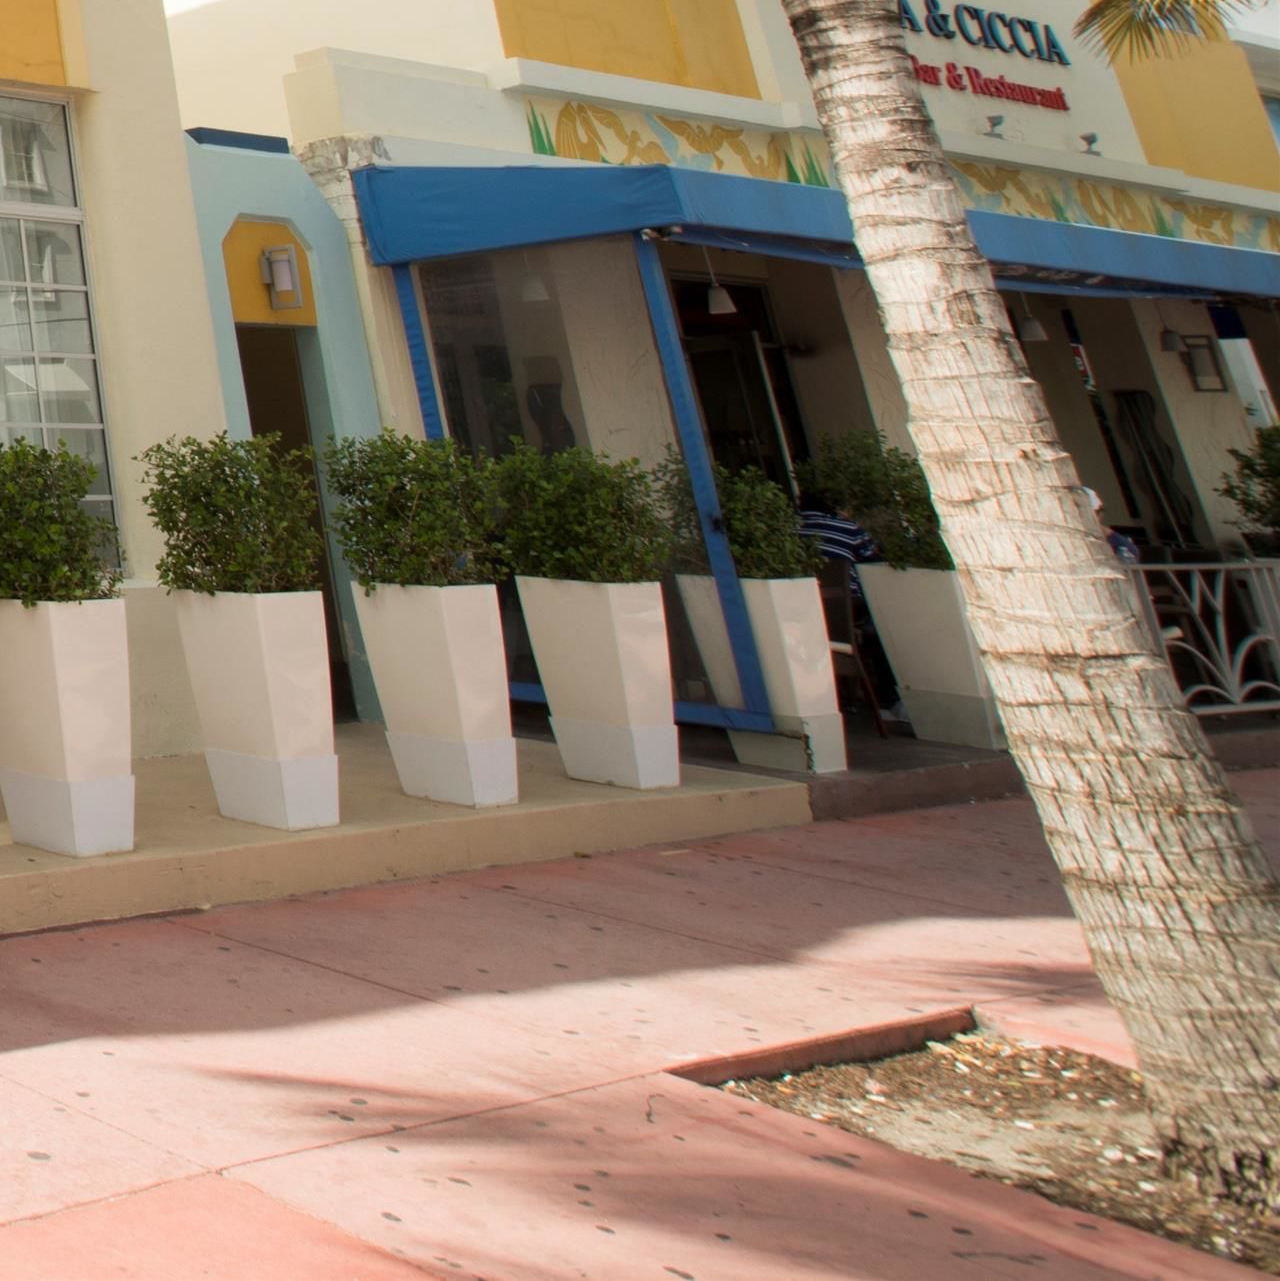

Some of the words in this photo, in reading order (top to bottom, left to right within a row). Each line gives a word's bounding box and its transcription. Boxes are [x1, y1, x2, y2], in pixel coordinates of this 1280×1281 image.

[954, 4, 1071, 65] CICCIA
[946, 62, 967, 91] &
[964, 66, 1070, 111] Restaurant
